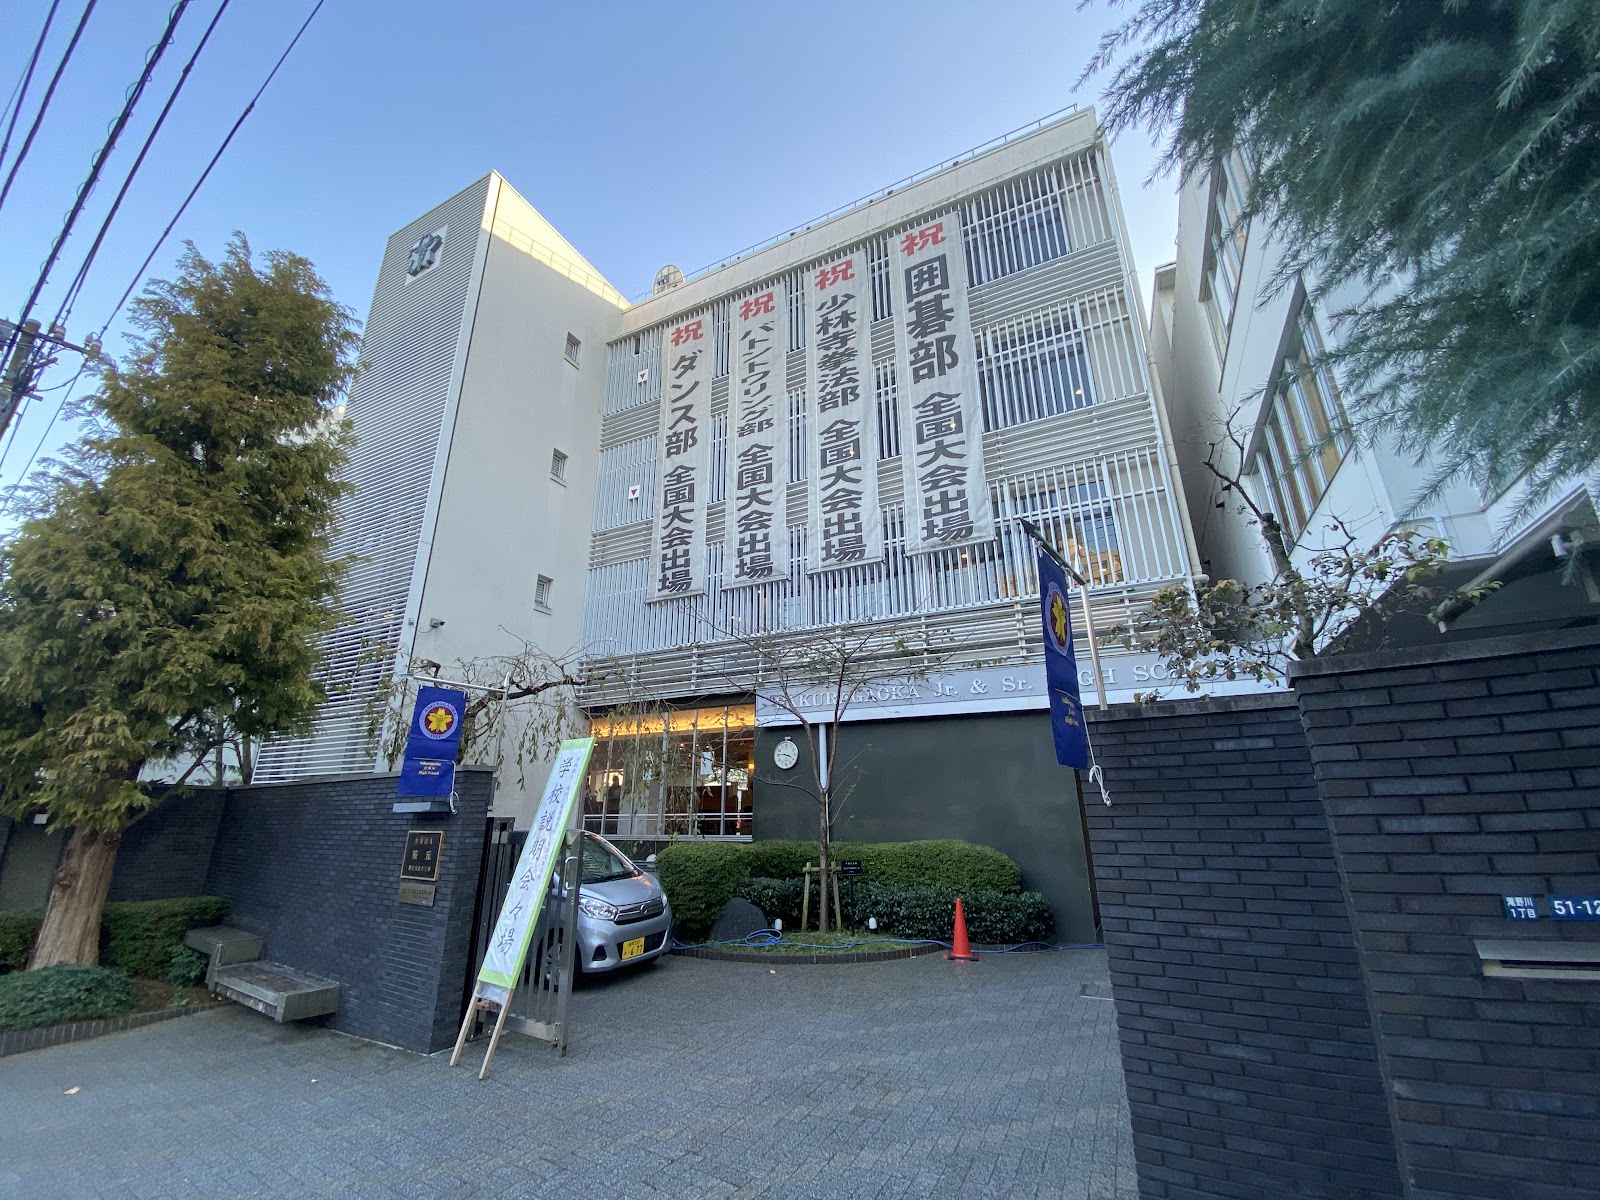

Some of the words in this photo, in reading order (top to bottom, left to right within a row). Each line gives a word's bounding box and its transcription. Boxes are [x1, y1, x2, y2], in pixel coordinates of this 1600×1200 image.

[814, 259, 855, 291] 祝
[900, 221, 947, 257] 祝
[670, 320, 704, 347] 祝
[739, 292, 775, 321] 祝
[815, 293, 861, 413] 少林寺拳法部
[905, 253, 959, 384] 囲碁部
[665, 348, 703, 459] ダンス部
[737, 321, 775, 438] バトントワリング部
[734, 443, 774, 580] 全国大会出場
[819, 419, 866, 563] 全国大会出場
[913, 391, 975, 542] 全国大会出場
[657, 464, 697, 593] 全国大会出場
[933, 681, 958, 697] Jr.
[970, 679, 988, 695] &
[1002, 676, 1033, 692] Sr.
[497, 757, 573, 956] 学校説明会々場
[1510, 908, 1536, 918] 1丁目
[1553, 900, 1600, 915] 51-12
